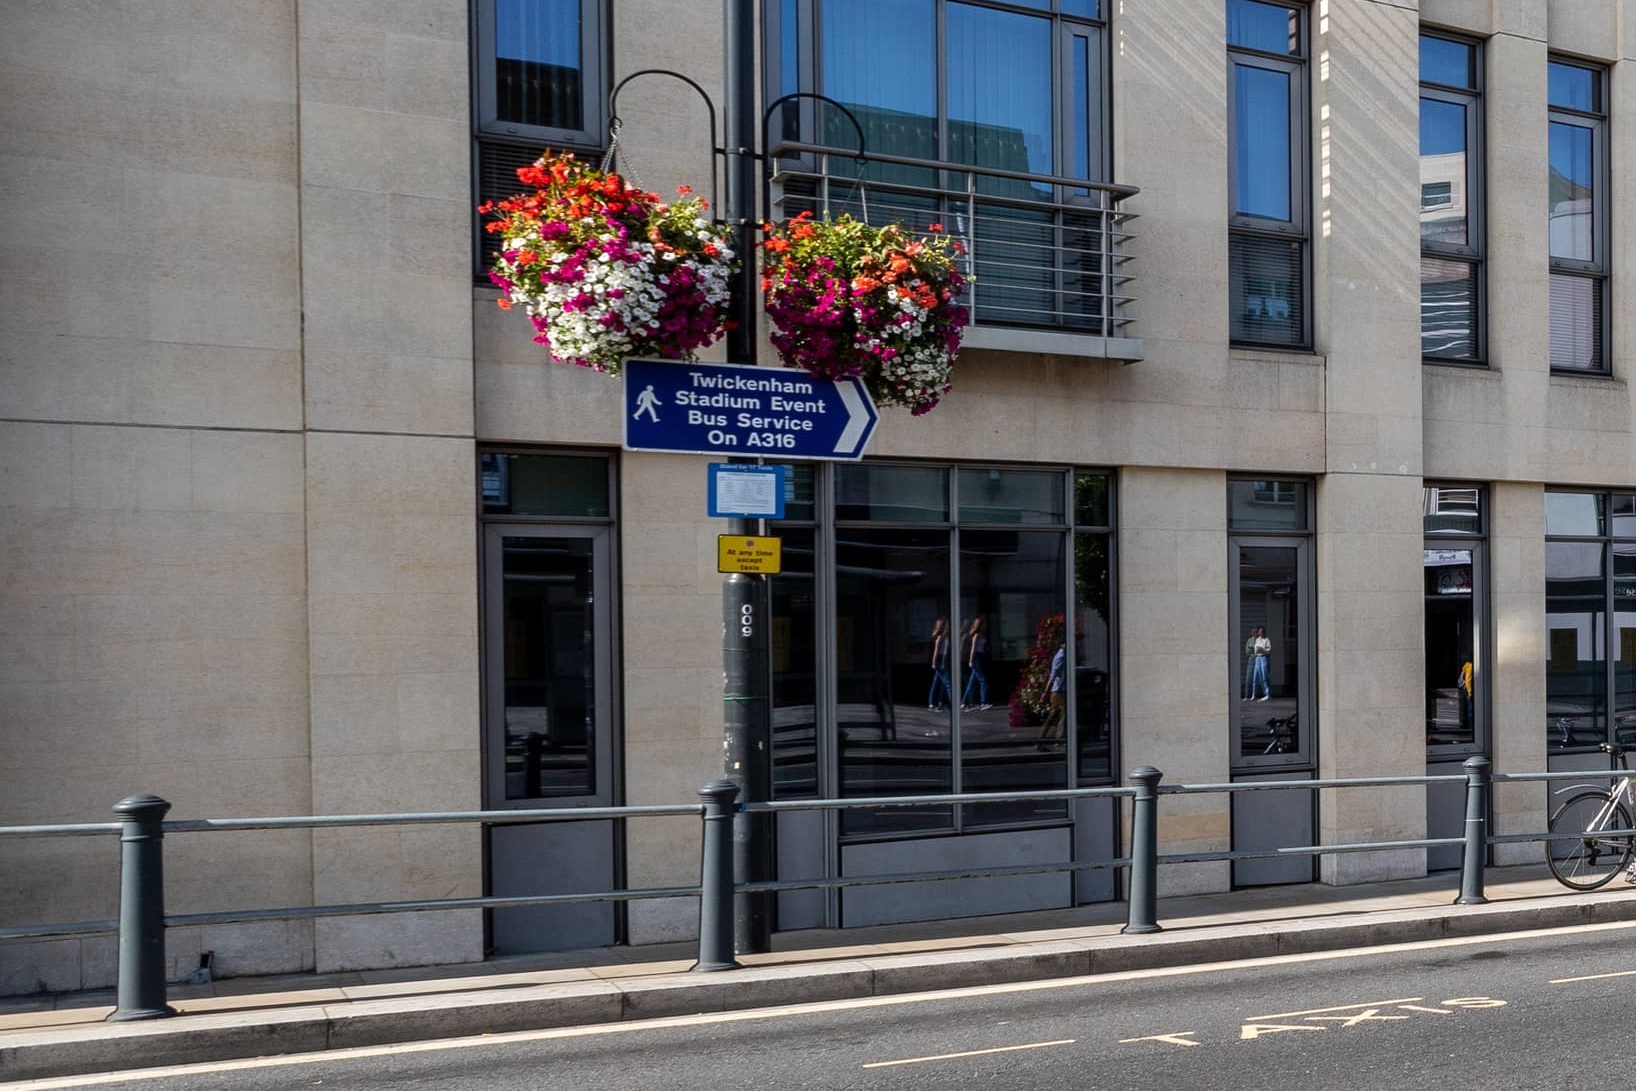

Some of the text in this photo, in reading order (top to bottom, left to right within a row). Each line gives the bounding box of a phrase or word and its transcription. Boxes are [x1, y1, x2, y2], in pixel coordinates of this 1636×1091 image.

[689, 372, 813, 394] Twickenham
[675, 390, 826, 414] Stadium Event
[688, 410, 813, 431] Bus Service
[707, 430, 796, 448] On A316
[736, 557, 763, 565] except
[739, 550, 752, 558] any
[1119, 997, 1508, 1047] TAXIS
